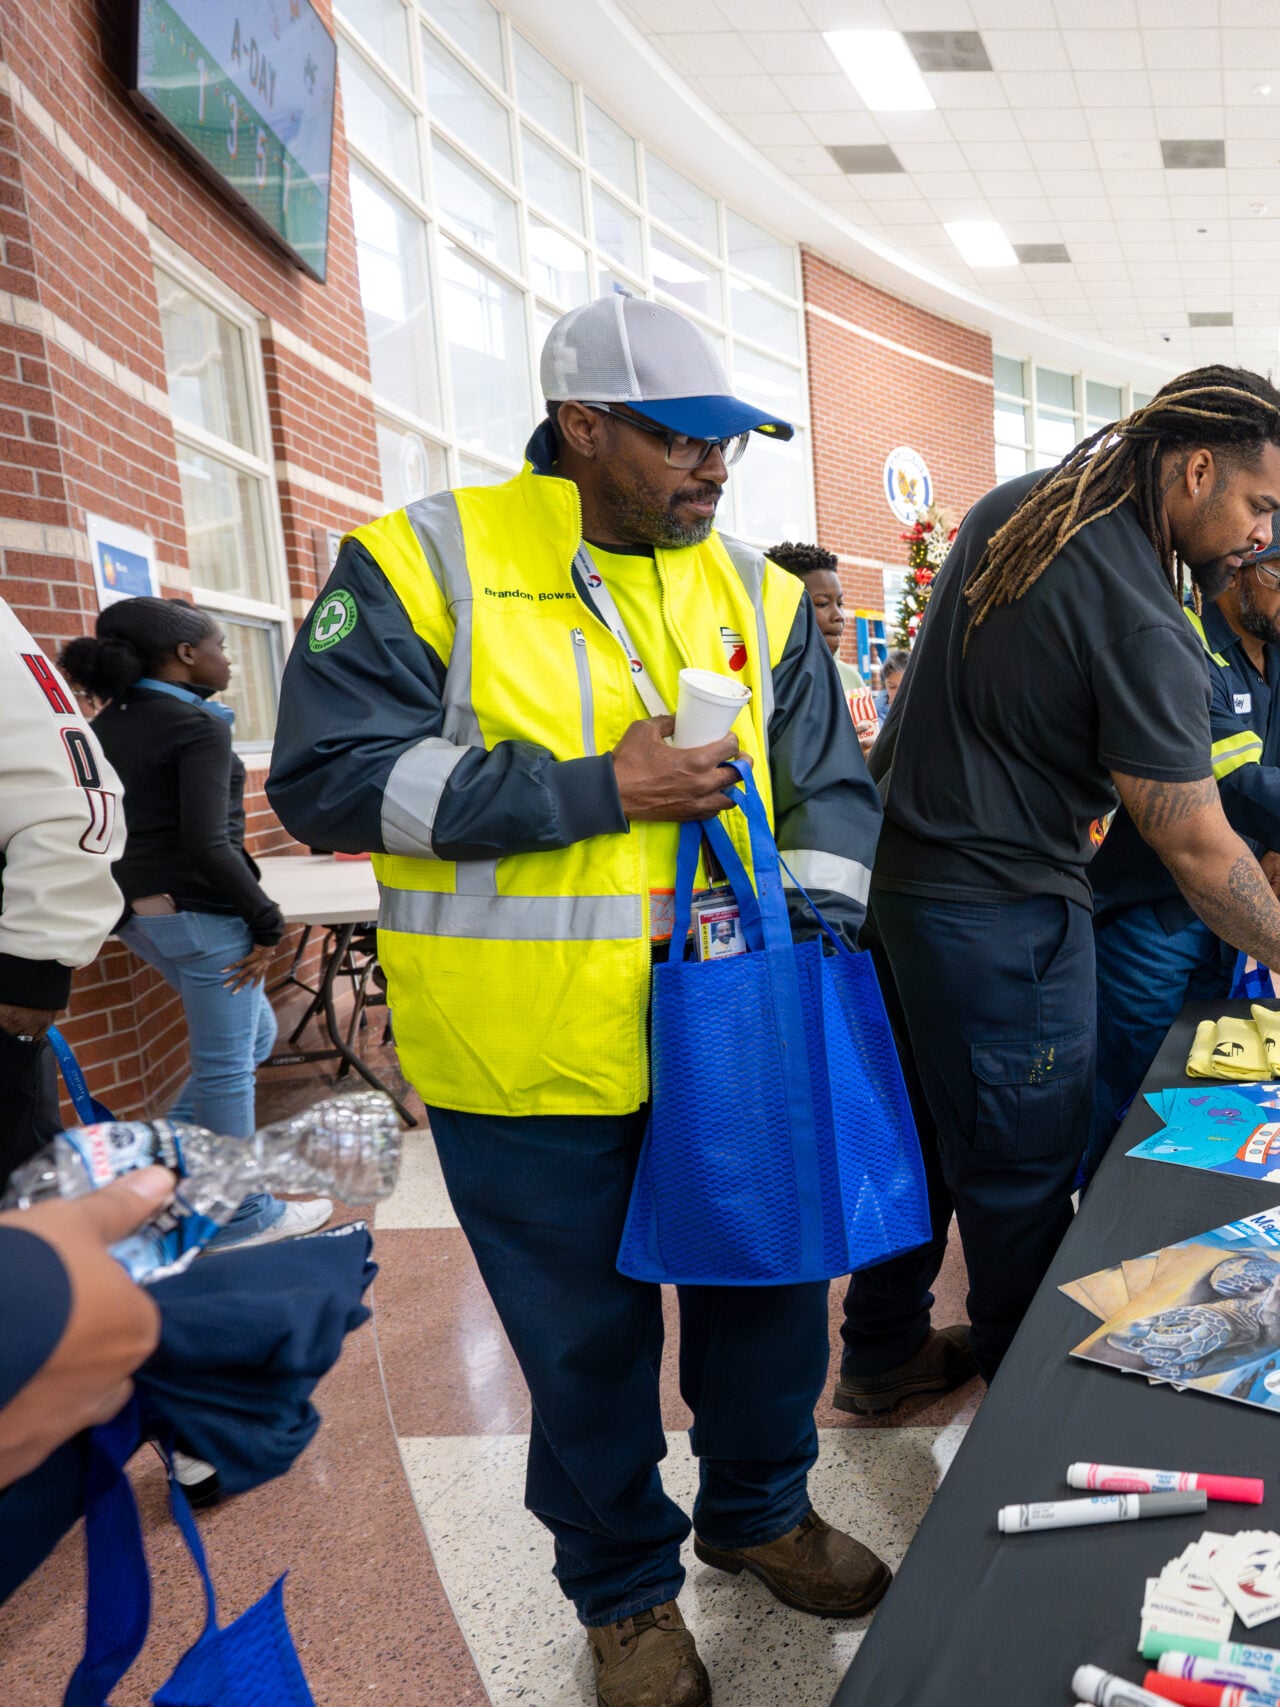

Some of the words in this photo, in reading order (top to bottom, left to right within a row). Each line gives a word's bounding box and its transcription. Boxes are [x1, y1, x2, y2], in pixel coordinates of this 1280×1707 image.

[231, 17, 276, 110] A-DAY
[484, 587, 534, 601] Brandon
[344, 606, 356, 631] SAFETY
